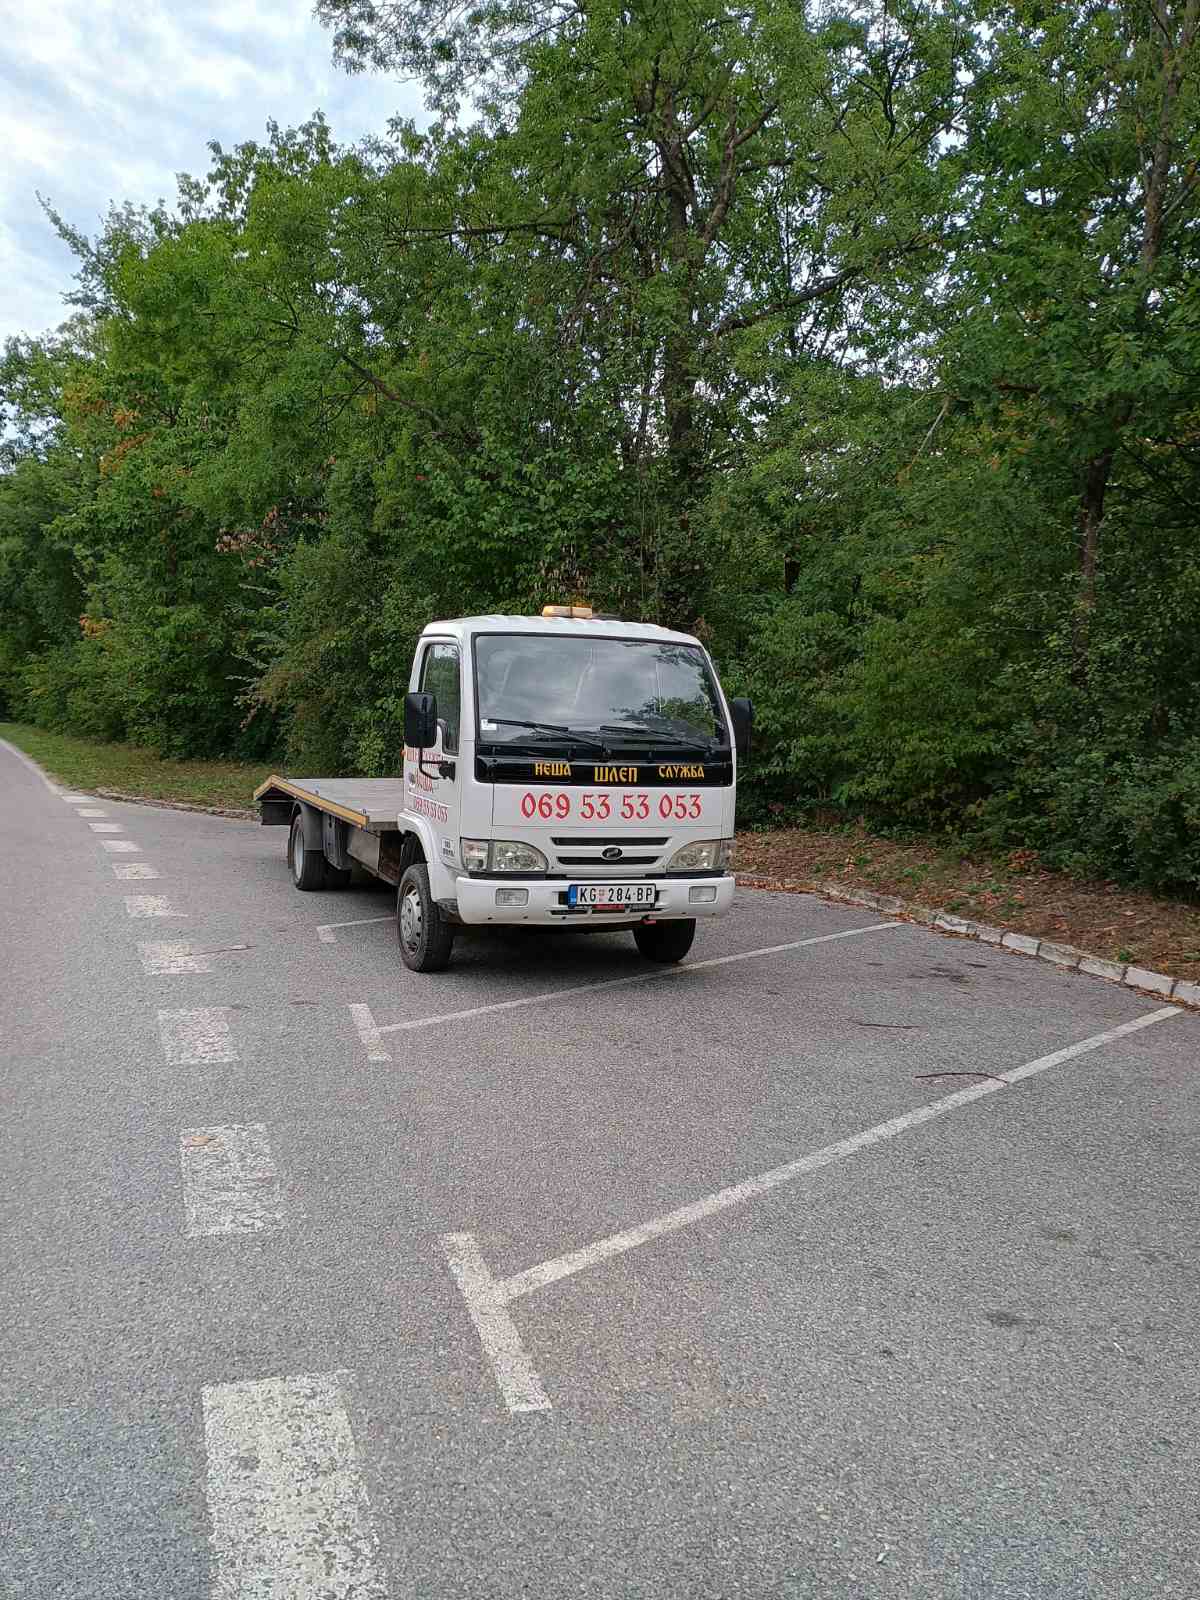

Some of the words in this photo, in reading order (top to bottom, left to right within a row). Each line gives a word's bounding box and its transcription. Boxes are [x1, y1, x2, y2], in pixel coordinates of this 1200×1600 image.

[534, 762, 572, 777] НЕША
[594, 766, 638, 783] ШЛЕП
[658, 765, 705, 779] СЛУЖБА
[521, 792, 571, 820] 069
[580, 793, 611, 820] 53
[620, 793, 650, 820] 53
[658, 793, 702, 820] 053
[579, 887, 597, 903] KG
